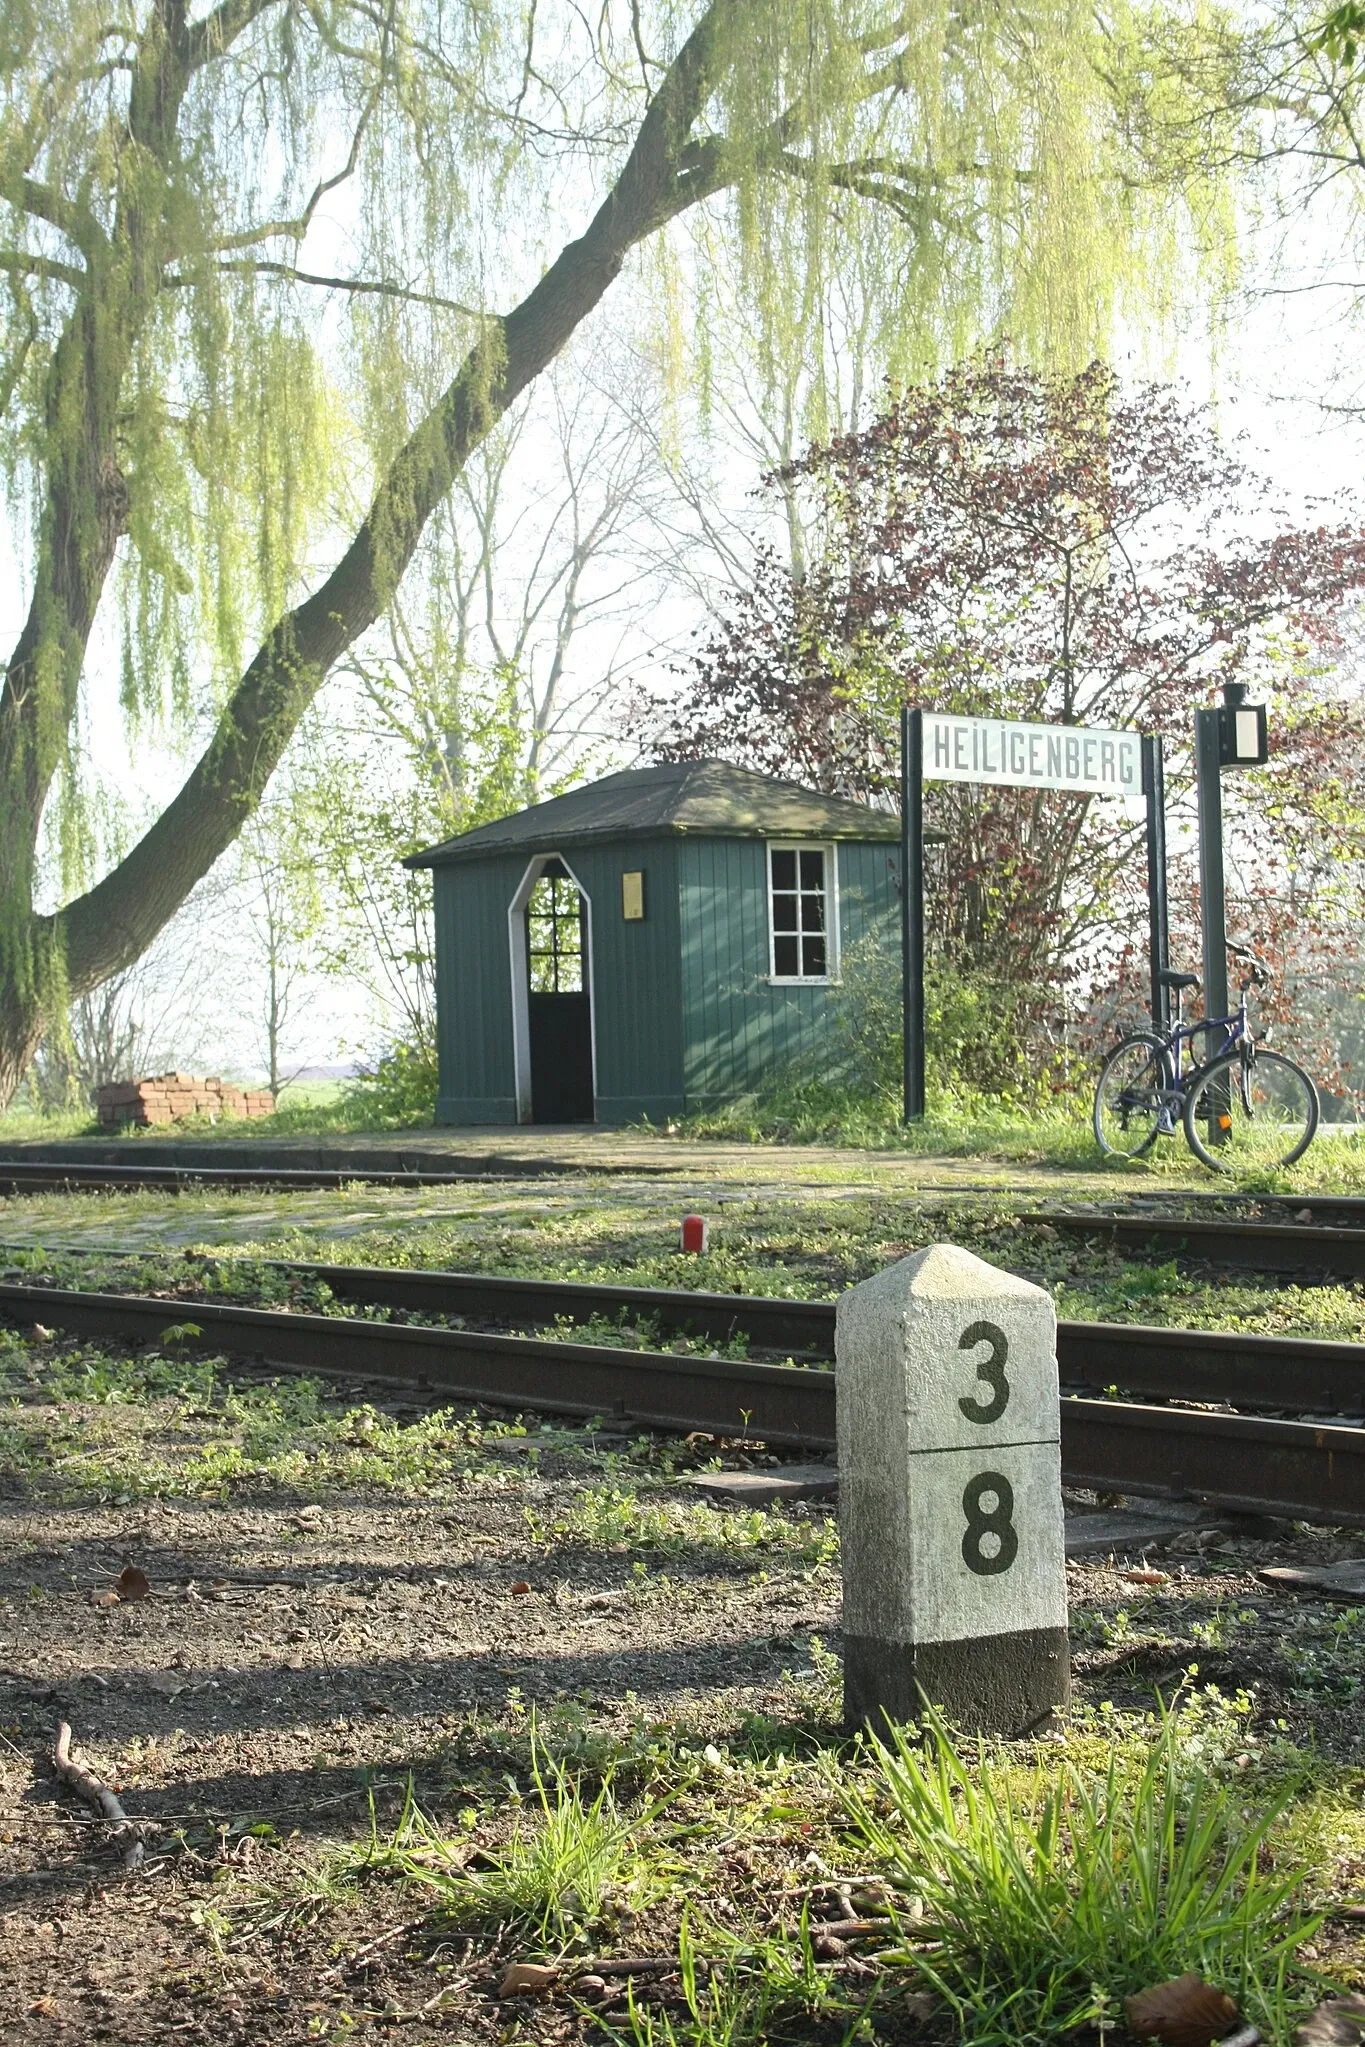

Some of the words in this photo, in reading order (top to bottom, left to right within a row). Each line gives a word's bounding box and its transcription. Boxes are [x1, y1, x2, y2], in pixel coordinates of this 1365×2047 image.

[934, 722, 1133, 784] HEILIGENBERG
[957, 1320, 1010, 1425] 3
[962, 1471, 1019, 1576] 8
